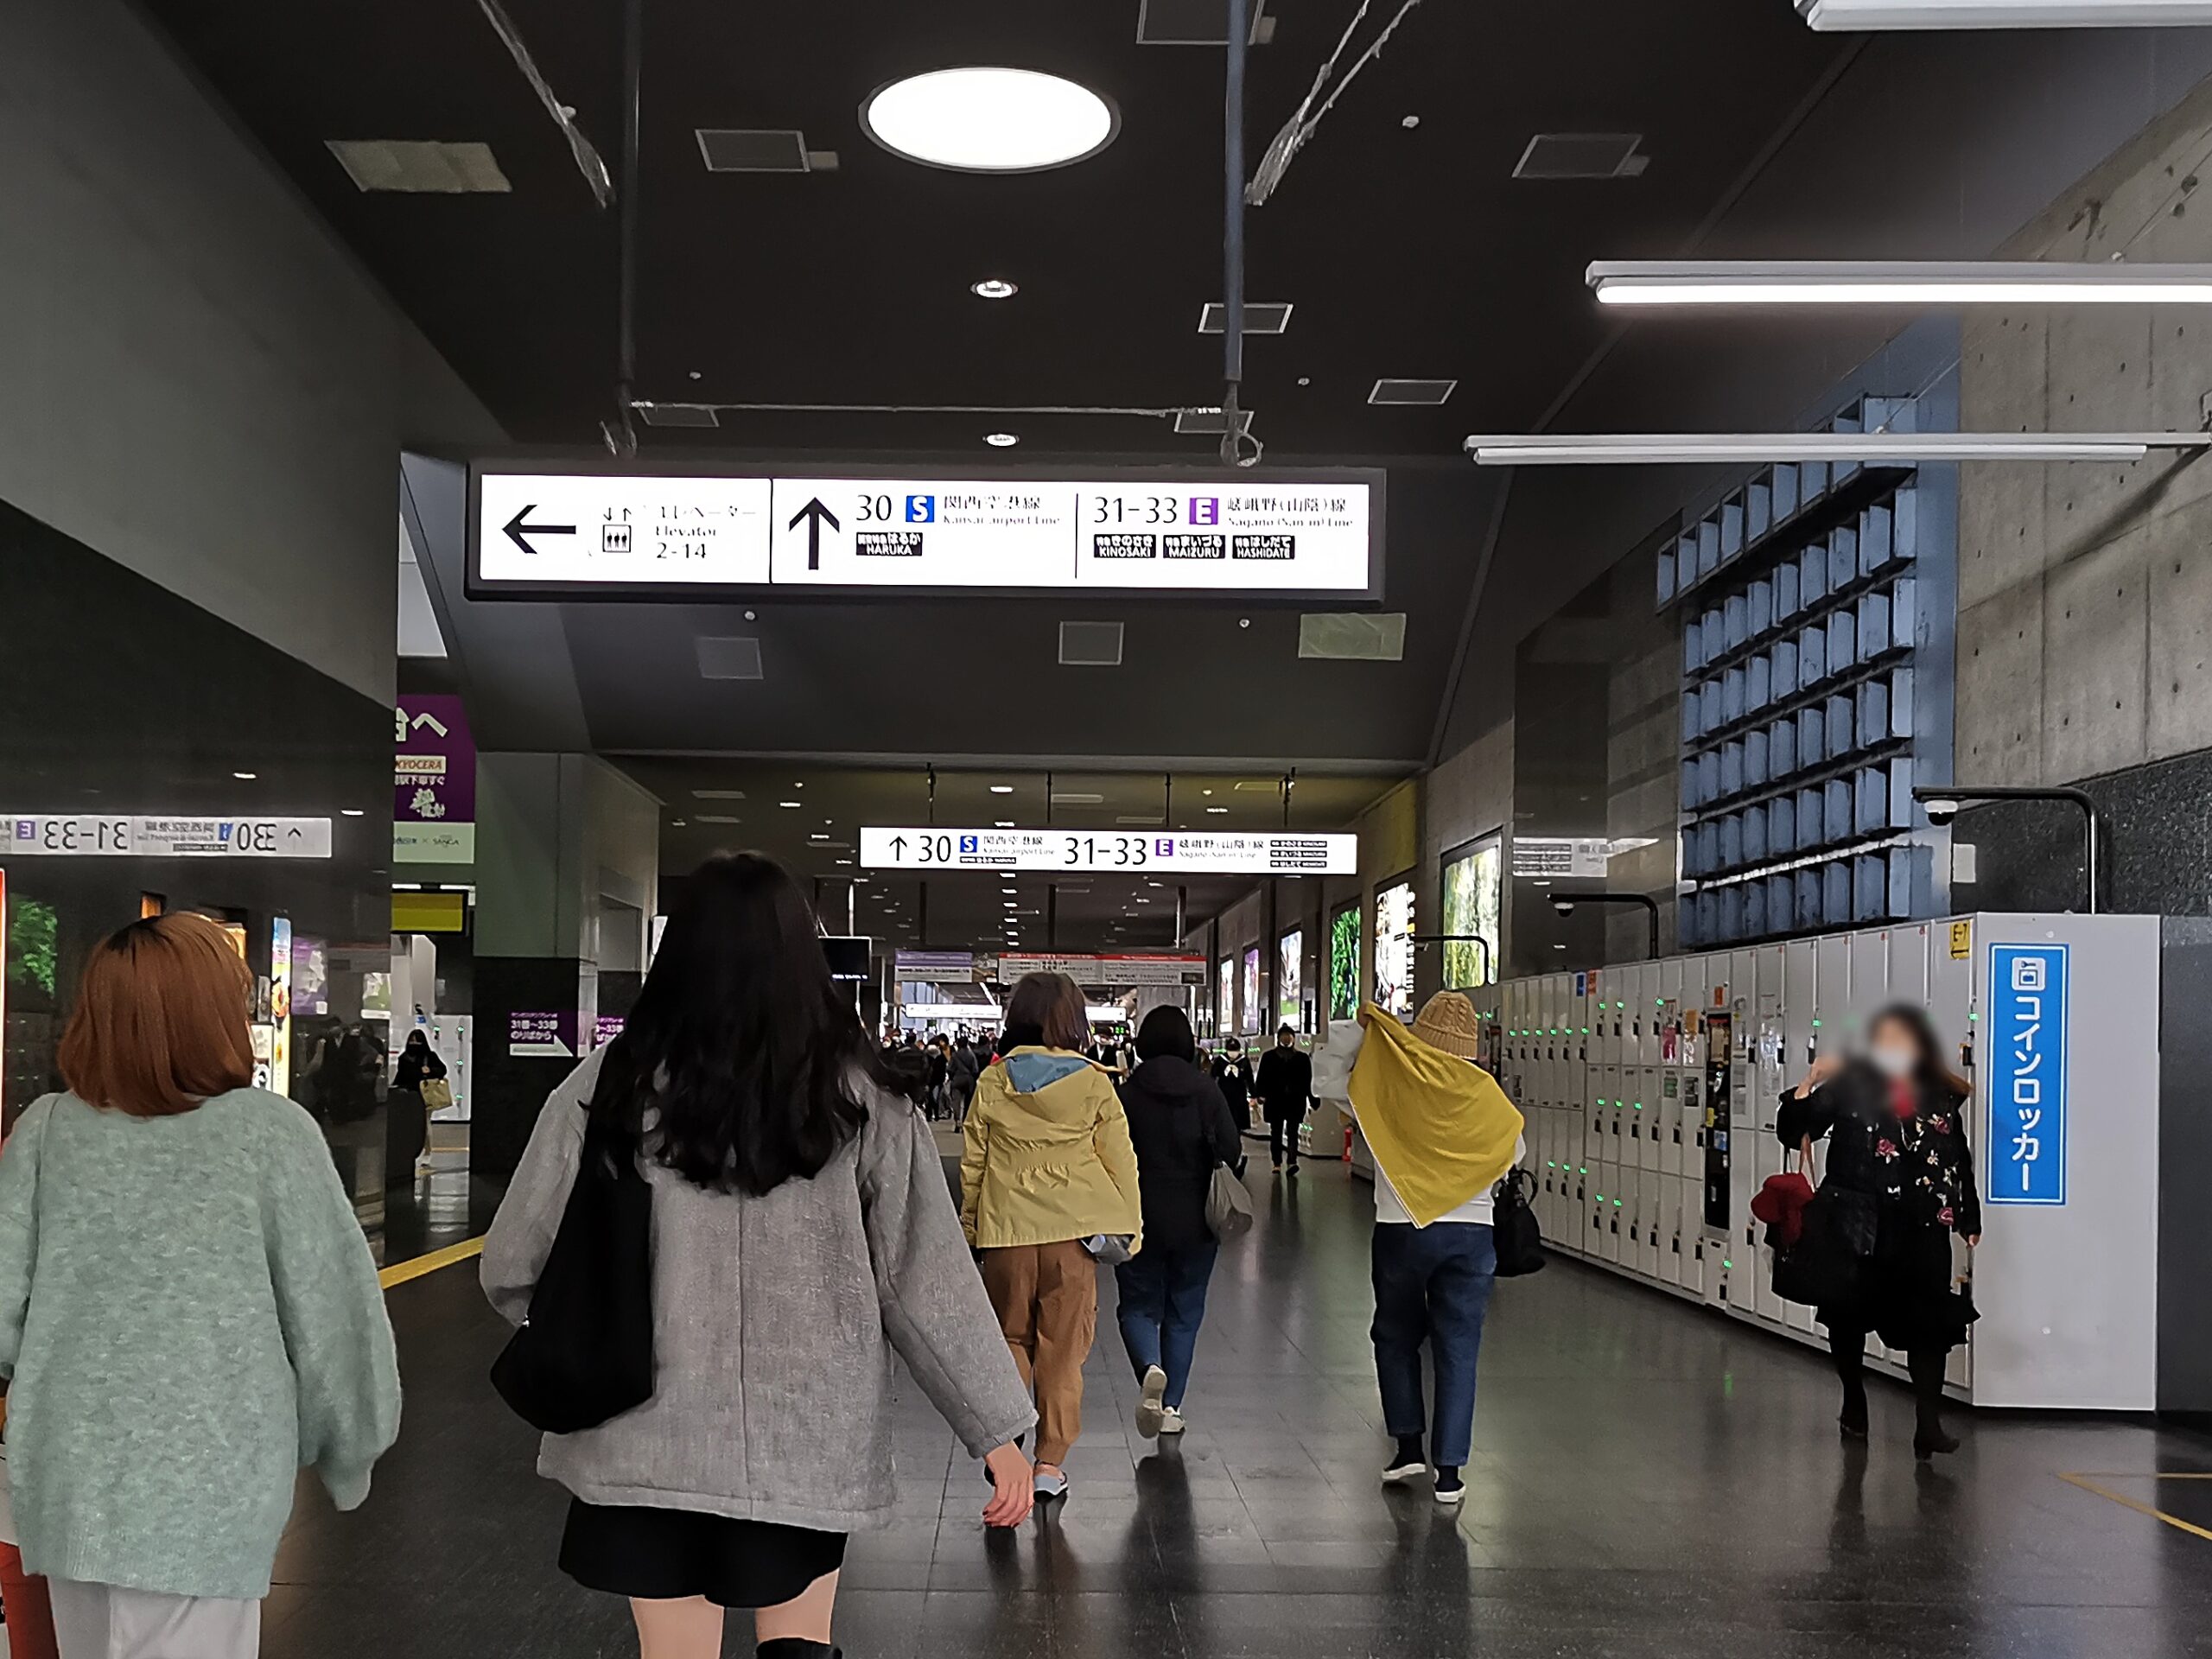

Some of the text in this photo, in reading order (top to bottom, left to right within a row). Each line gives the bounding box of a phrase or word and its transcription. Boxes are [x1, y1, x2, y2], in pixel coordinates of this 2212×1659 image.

[855, 495, 929, 523] 30 S
[1094, 497, 1212, 524] 31-33 E
[656, 542, 707, 559] 2-14
[866, 544, 913, 556] HARUKA
[1099, 546, 1151, 557] KINOSAKI
[1168, 546, 1220, 558] MAIZURU
[1236, 547, 1291, 559] HASHIDATE
[918, 836, 975, 862] 30 S
[1065, 837, 1147, 866] 31-33
[2012, 995, 2041, 1192] コインロッカー
